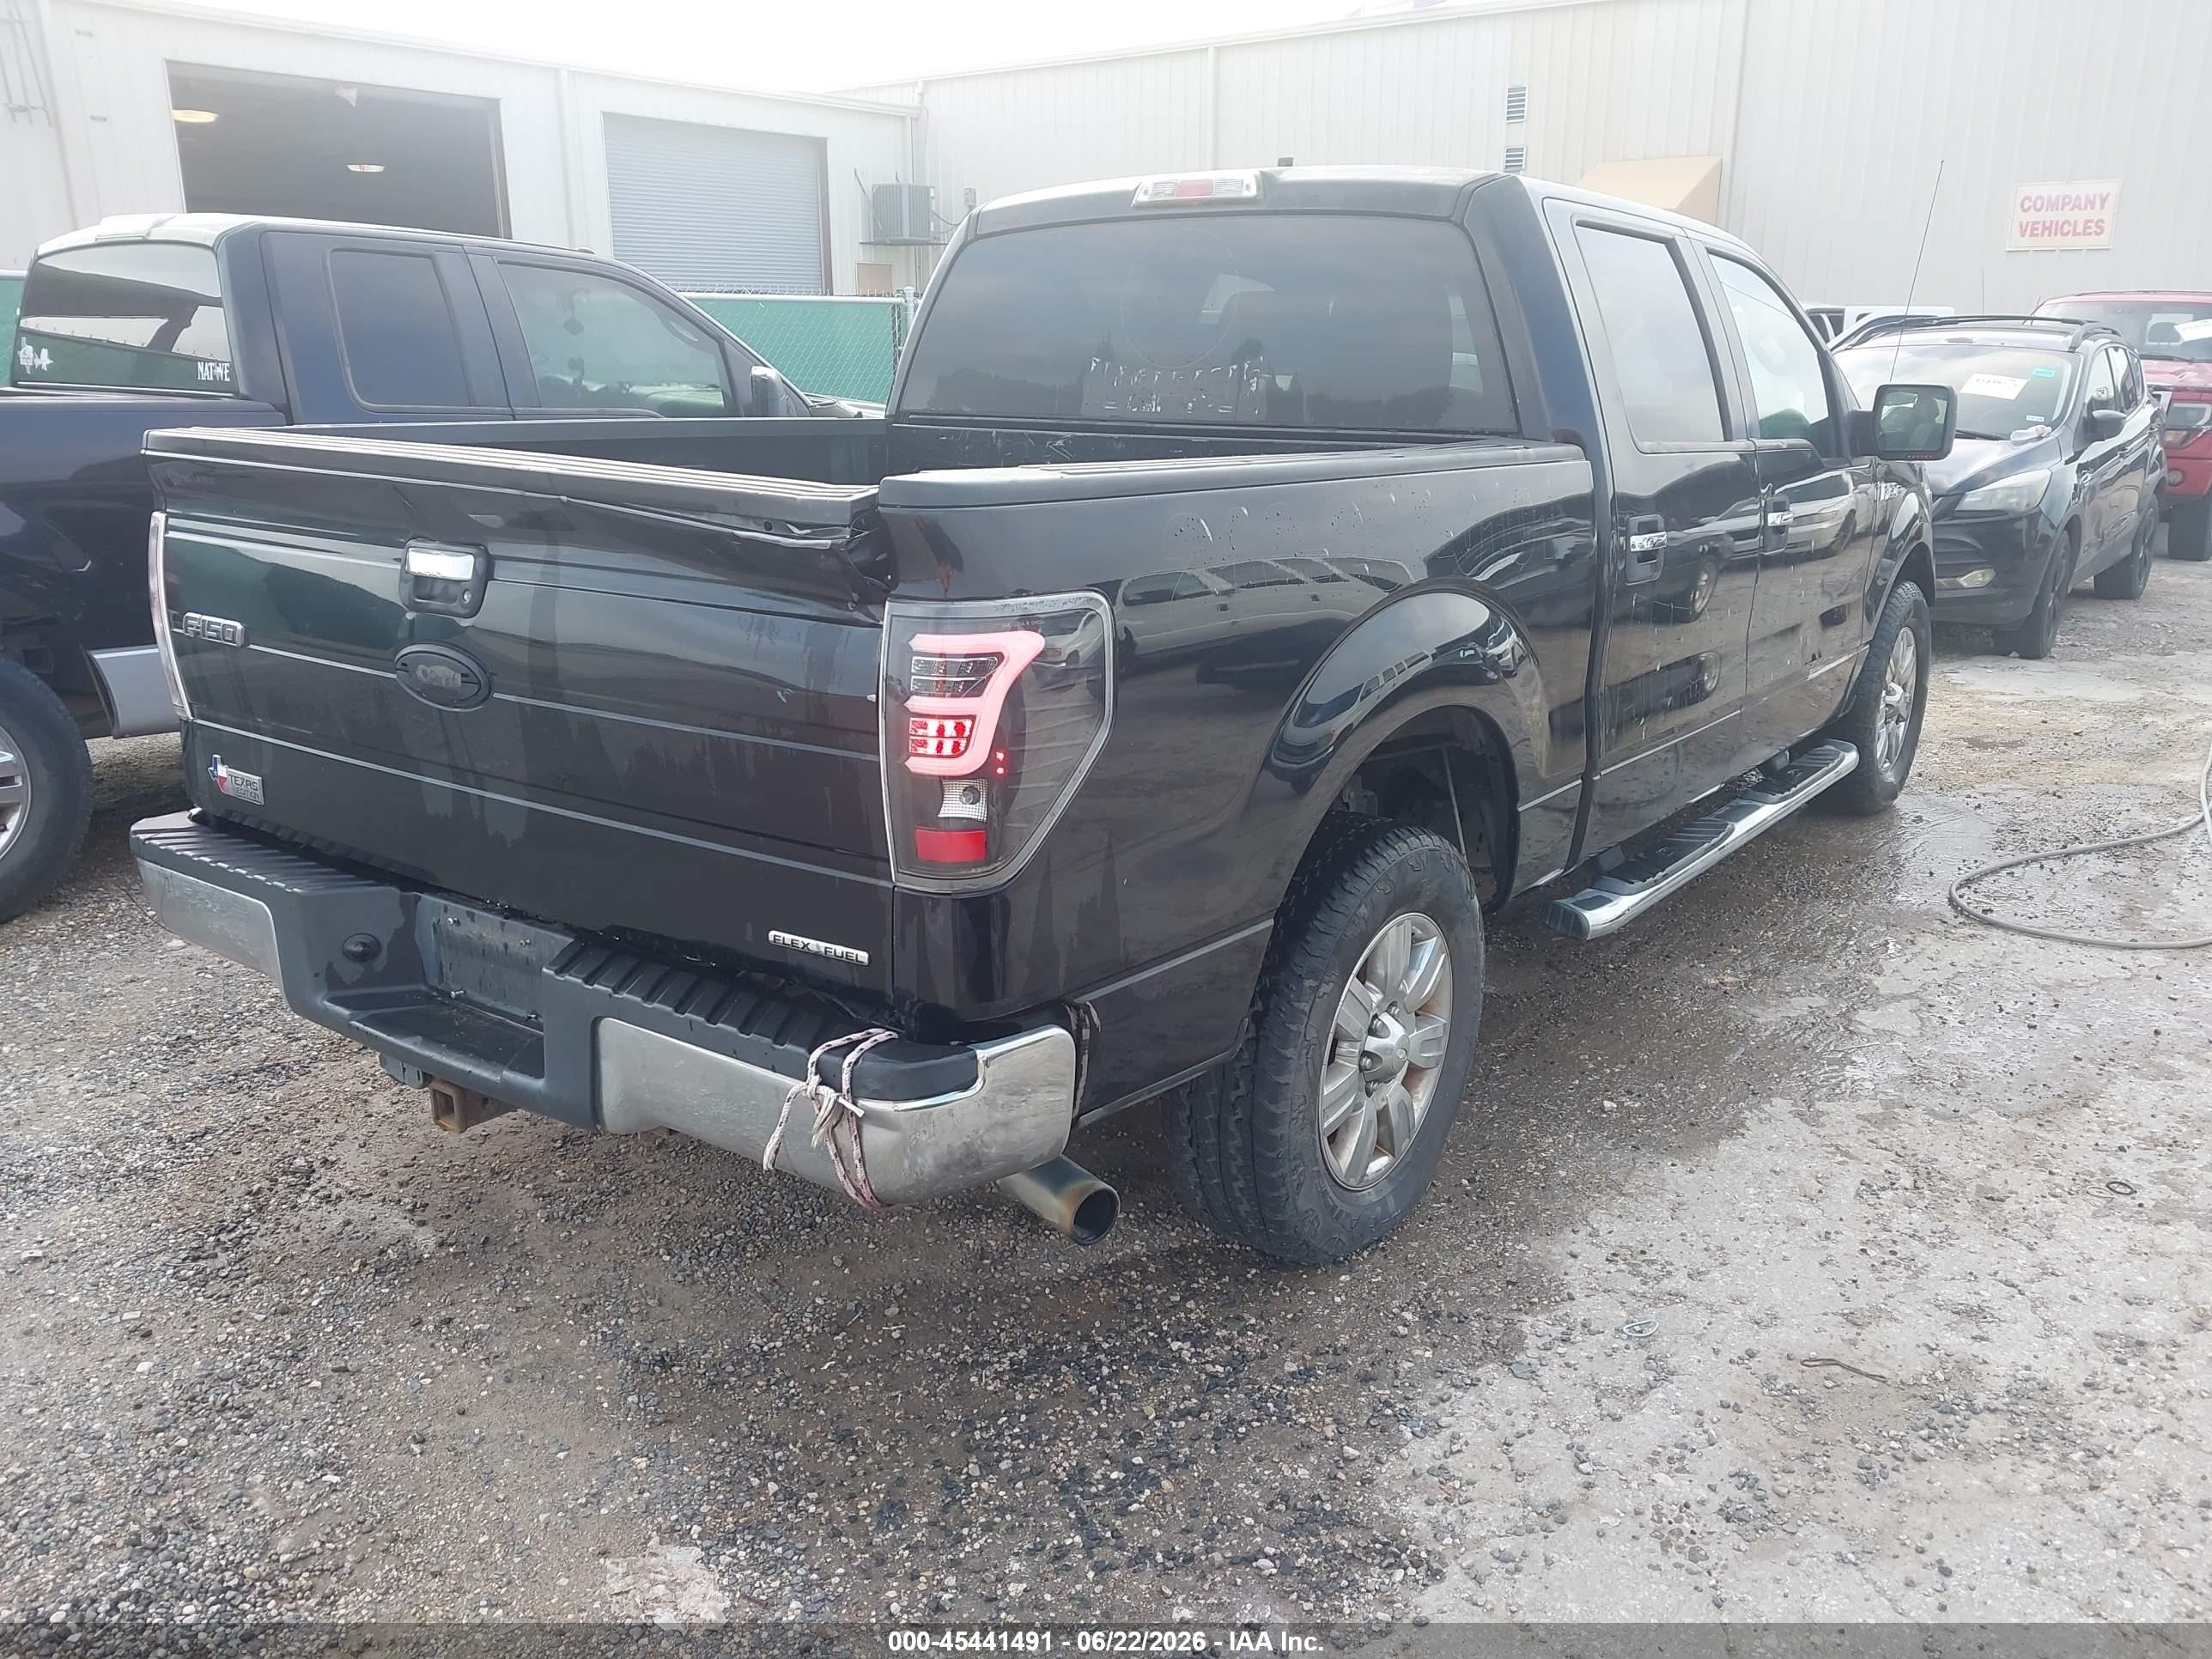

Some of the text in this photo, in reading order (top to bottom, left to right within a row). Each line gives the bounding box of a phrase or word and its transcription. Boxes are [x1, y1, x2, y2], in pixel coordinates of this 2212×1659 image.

[2020, 192, 2111, 213] COMPANY
[2019, 218, 2106, 238] VEHICLES
[228, 774, 258, 792] TEXAS
[823, 946, 865, 963] FUEL
